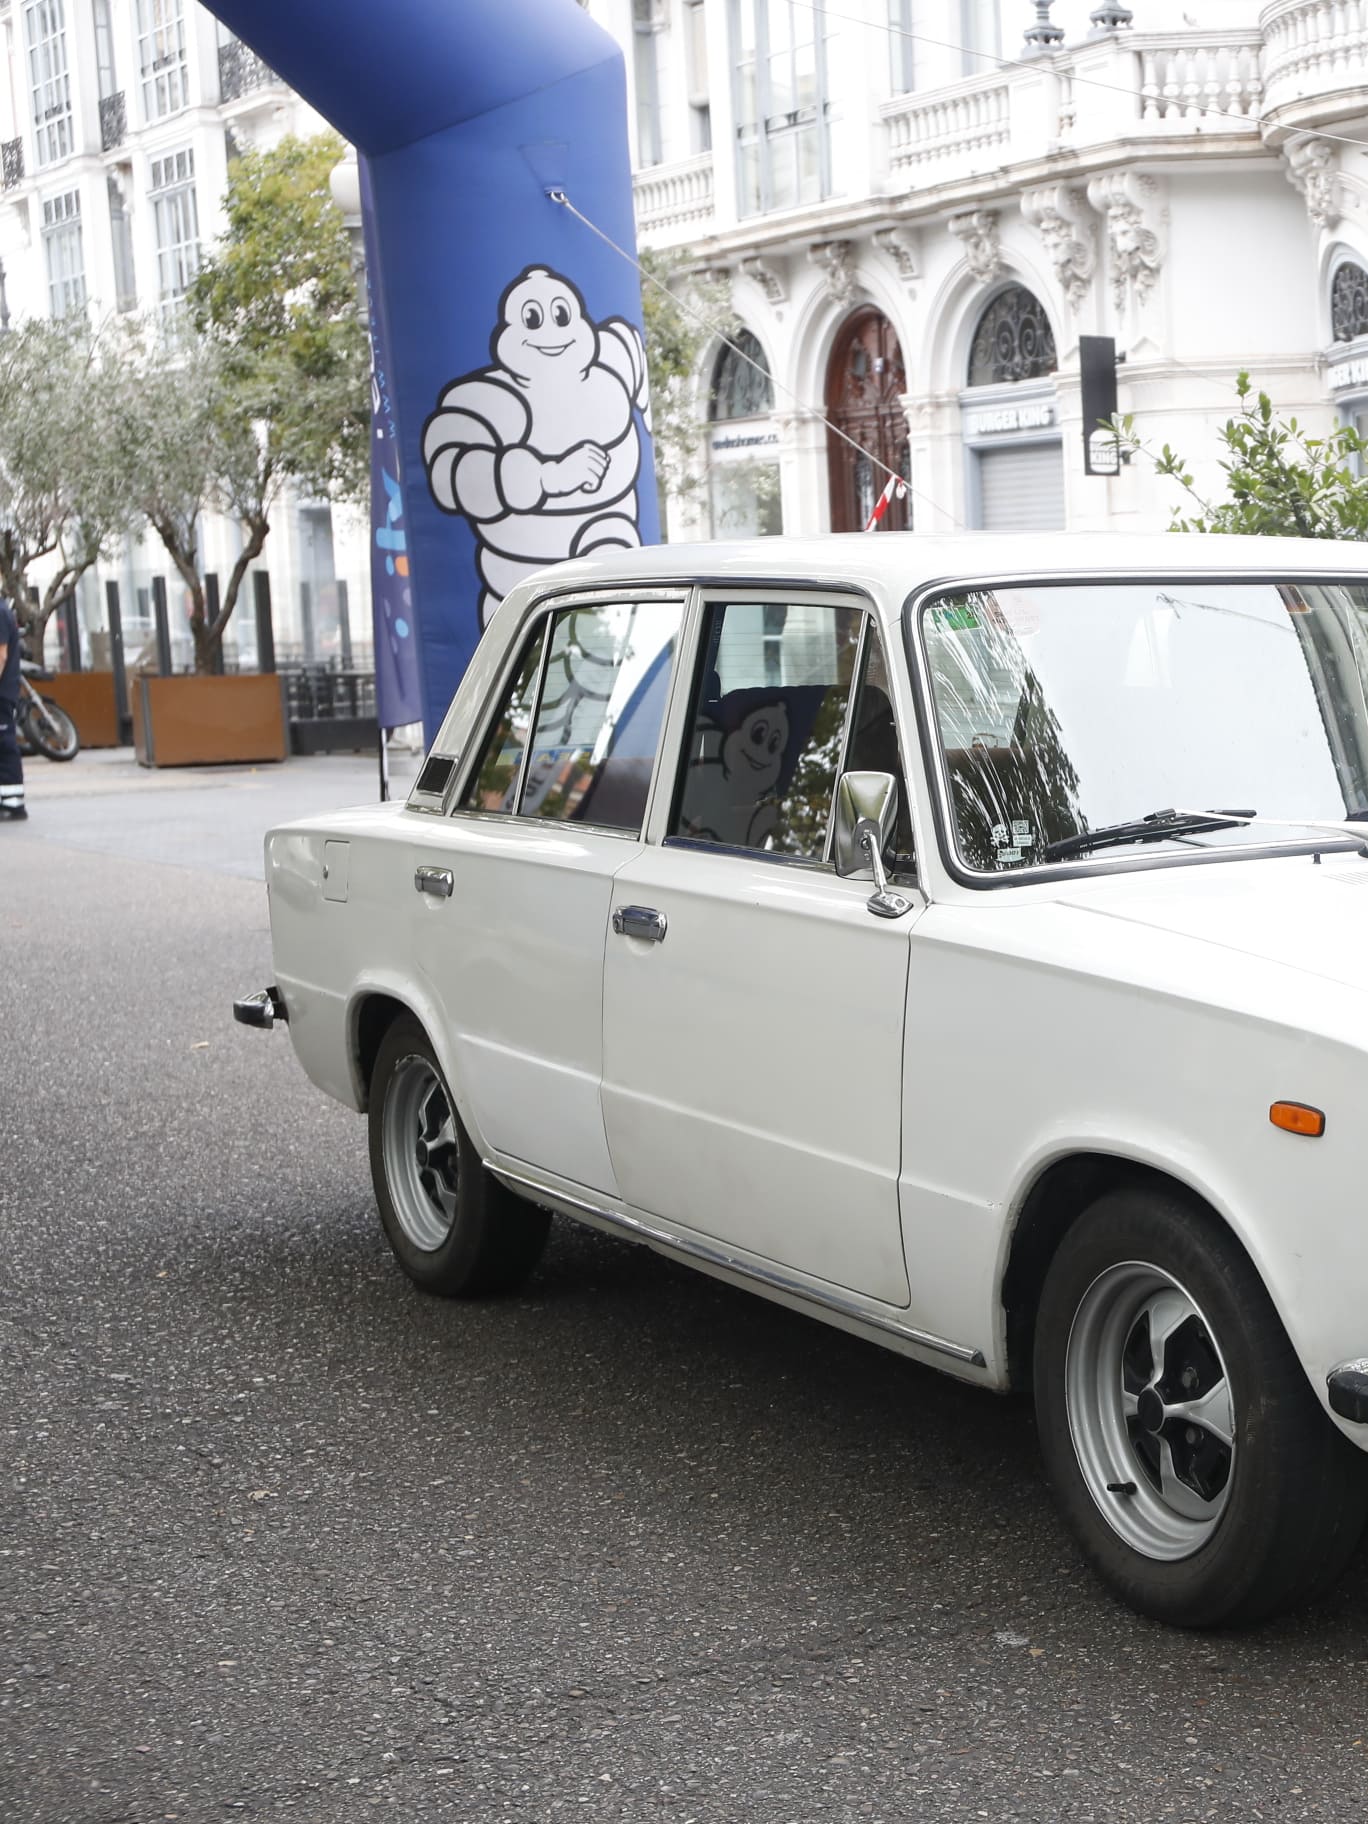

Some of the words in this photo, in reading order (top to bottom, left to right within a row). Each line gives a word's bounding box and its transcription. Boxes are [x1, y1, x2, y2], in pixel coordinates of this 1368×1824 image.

[967, 410, 1018, 433] BURGER
[1019, 405, 1052, 428] KING
[1092, 451, 1118, 464] KING
